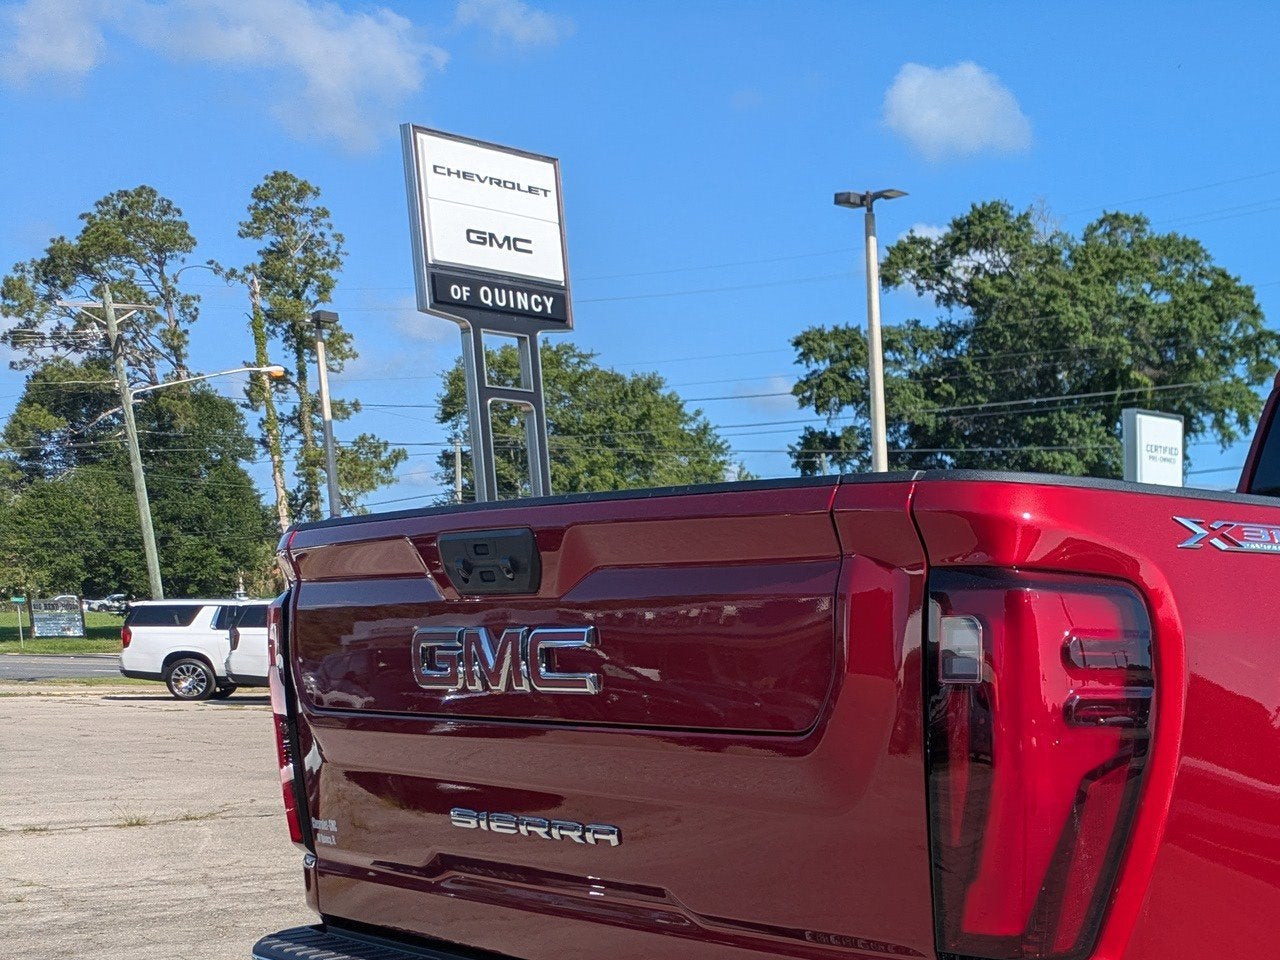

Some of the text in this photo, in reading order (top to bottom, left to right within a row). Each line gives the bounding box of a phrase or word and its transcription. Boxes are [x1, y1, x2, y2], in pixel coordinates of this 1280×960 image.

[432, 164, 552, 198] CHEVROLET
[465, 228, 533, 254] GMC
[450, 284, 553, 314] OF QUINCY
[1146, 444, 1179, 466] CERTIFIED
[411, 625, 599, 694] GMC
[450, 807, 623, 847] SIERRA
